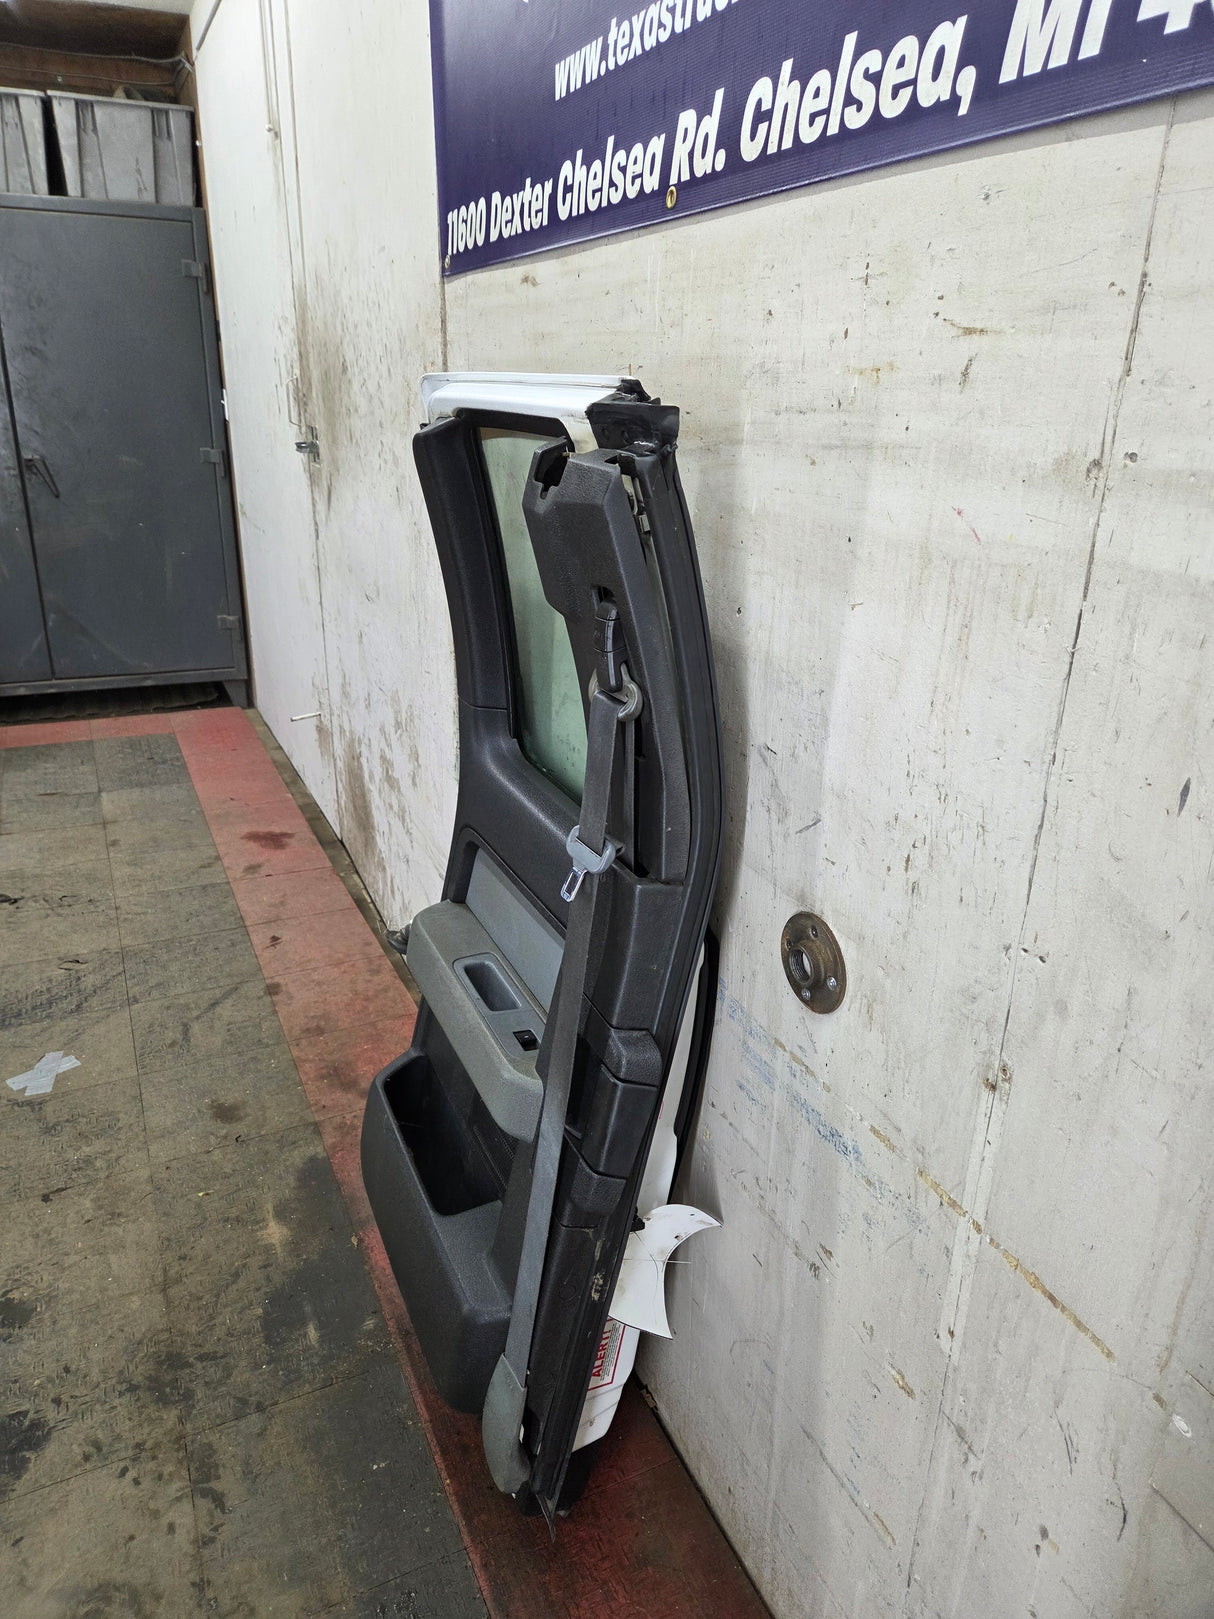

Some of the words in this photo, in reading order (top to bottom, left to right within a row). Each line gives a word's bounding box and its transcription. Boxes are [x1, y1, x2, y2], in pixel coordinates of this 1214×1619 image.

[554, 0, 739, 101] www.texastr
[446, 196, 487, 256] 11600
[490, 177, 553, 242] Dexter
[557, 133, 666, 221] Chelsea
[669, 87, 727, 186] Rd.
[739, 15, 977, 162] Chelsea,
[999, 0, 1113, 85] MI
[591, 1329, 611, 1377] ALERT!
